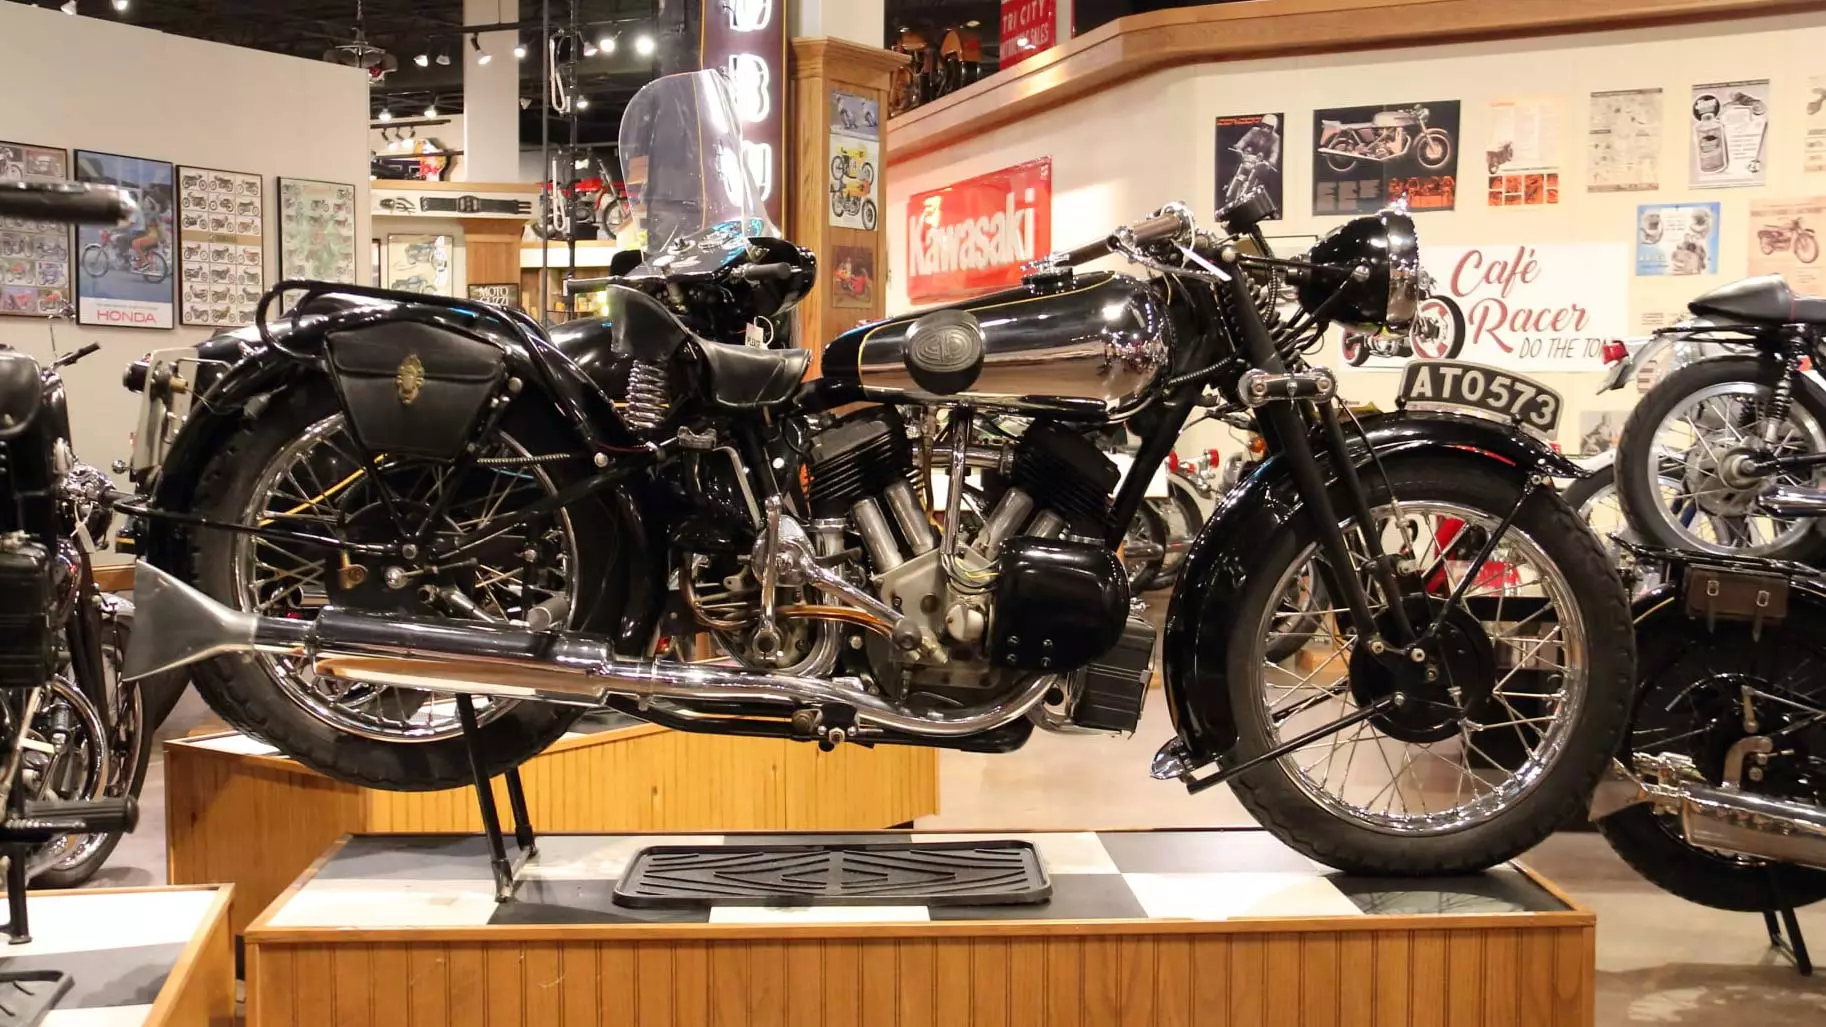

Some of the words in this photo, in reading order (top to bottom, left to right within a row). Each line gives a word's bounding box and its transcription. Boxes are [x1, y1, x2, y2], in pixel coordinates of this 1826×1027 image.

[1003, 11, 1017, 35] TRI
[1020, 0, 1044, 25] CITY
[909, 188, 1035, 277] Kawasaki
[1450, 246, 1541, 298] Café
[479, 286, 509, 298] MOTO
[96, 309, 158, 325] HONDA
[1468, 297, 1589, 353] Racer
[1519, 337, 1543, 359] DO
[1548, 337, 1577, 359] THE
